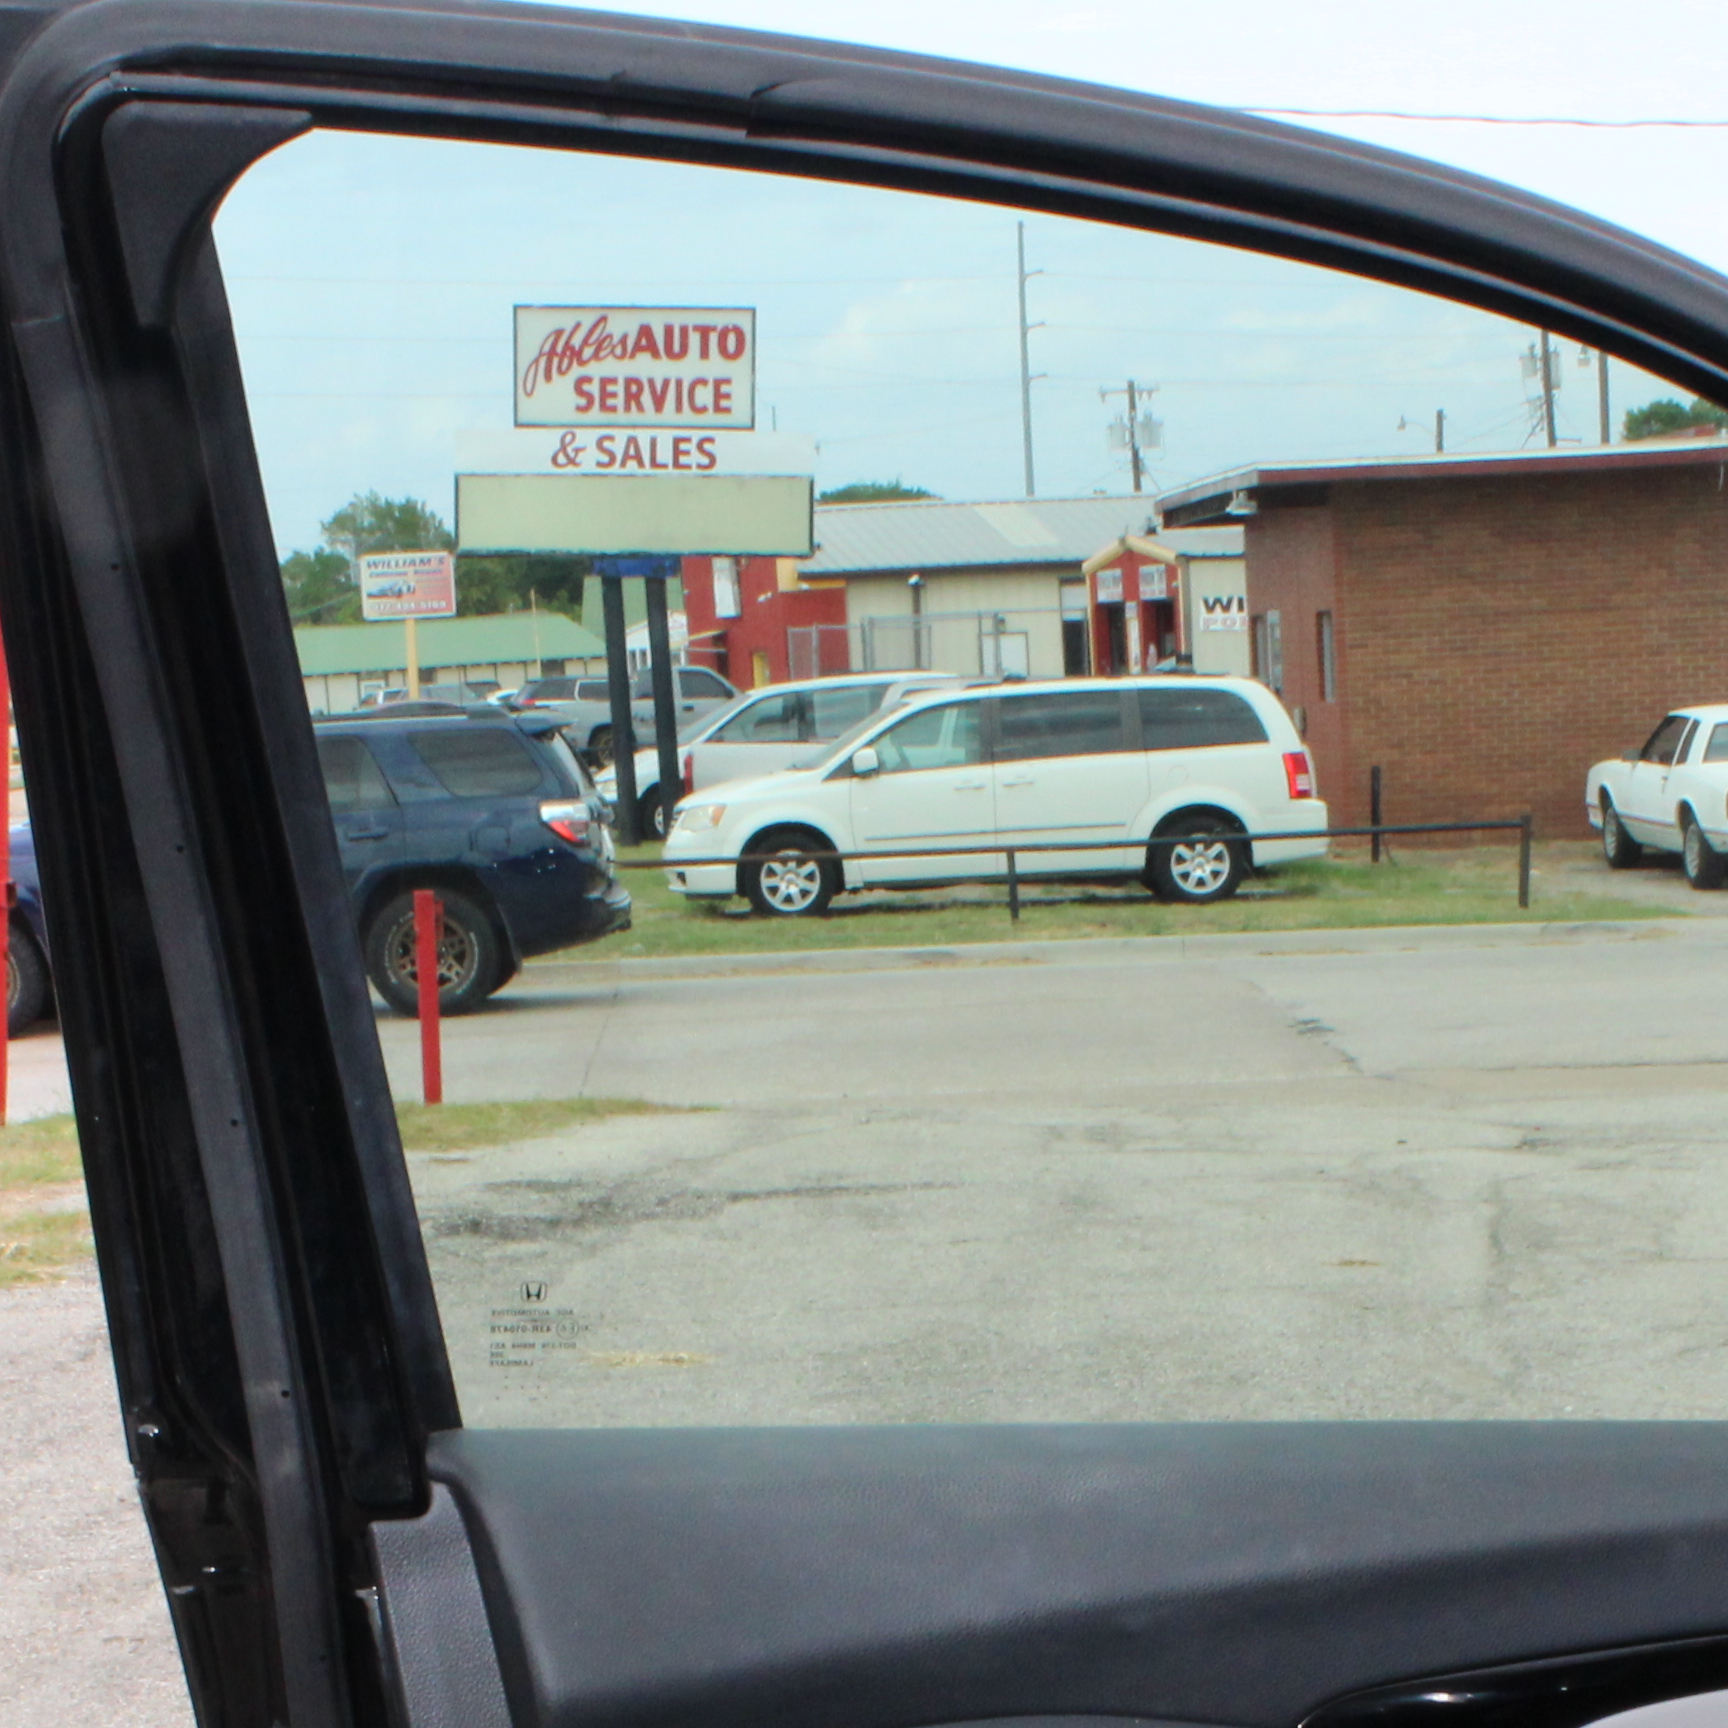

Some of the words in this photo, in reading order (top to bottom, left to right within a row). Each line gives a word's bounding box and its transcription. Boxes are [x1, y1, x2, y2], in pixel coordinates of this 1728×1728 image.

[523, 315, 629, 397] Ables
[628, 323, 746, 361] AUTO
[573, 375, 732, 415] SERVICE
[551, 430, 587, 470] &
[595, 434, 717, 471] SALES
